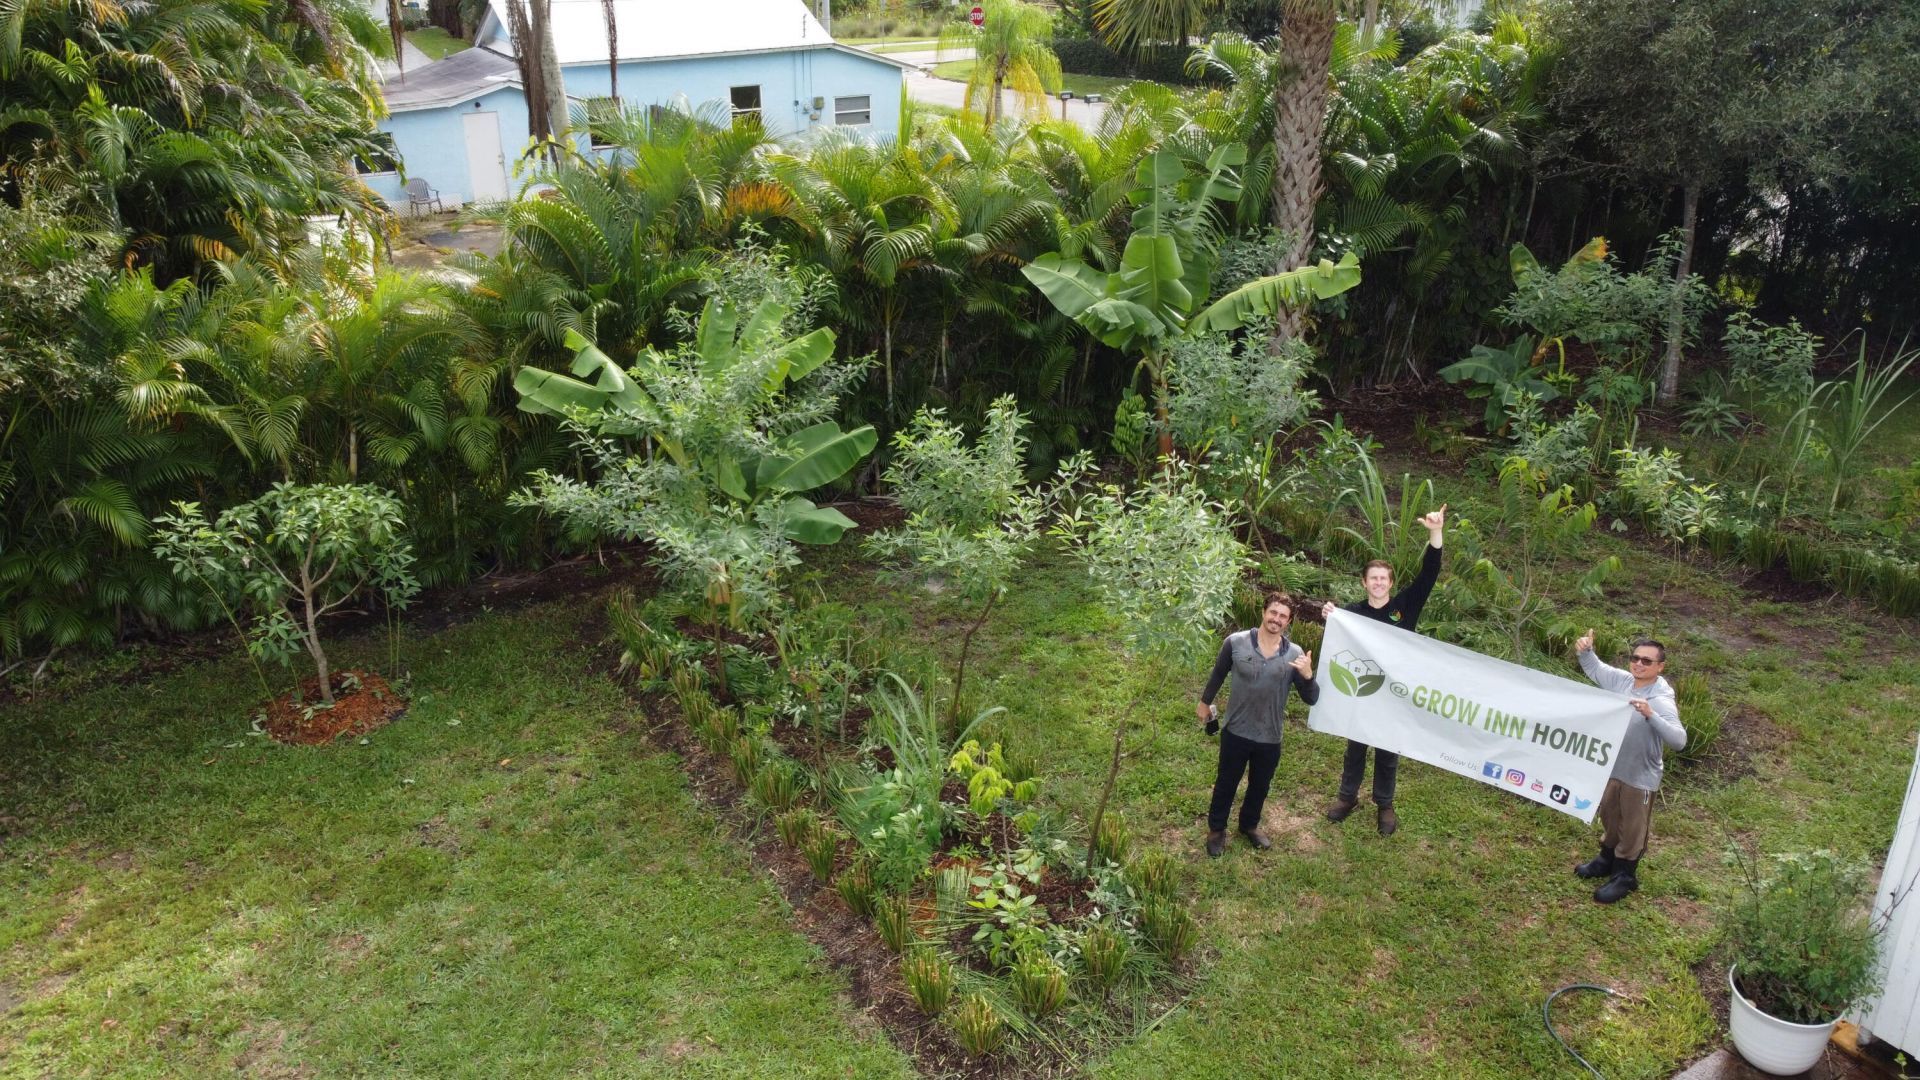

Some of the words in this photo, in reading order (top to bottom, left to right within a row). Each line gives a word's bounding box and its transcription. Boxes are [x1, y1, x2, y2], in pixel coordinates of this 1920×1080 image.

[970, 12, 984, 20] STOP
[1411, 685, 1481, 726] GROW
[1483, 707, 1527, 740] INN
[1531, 722, 1612, 767] HOMES
[1440, 752, 1466, 767] Follow
[1467, 761, 1478, 771] Us
